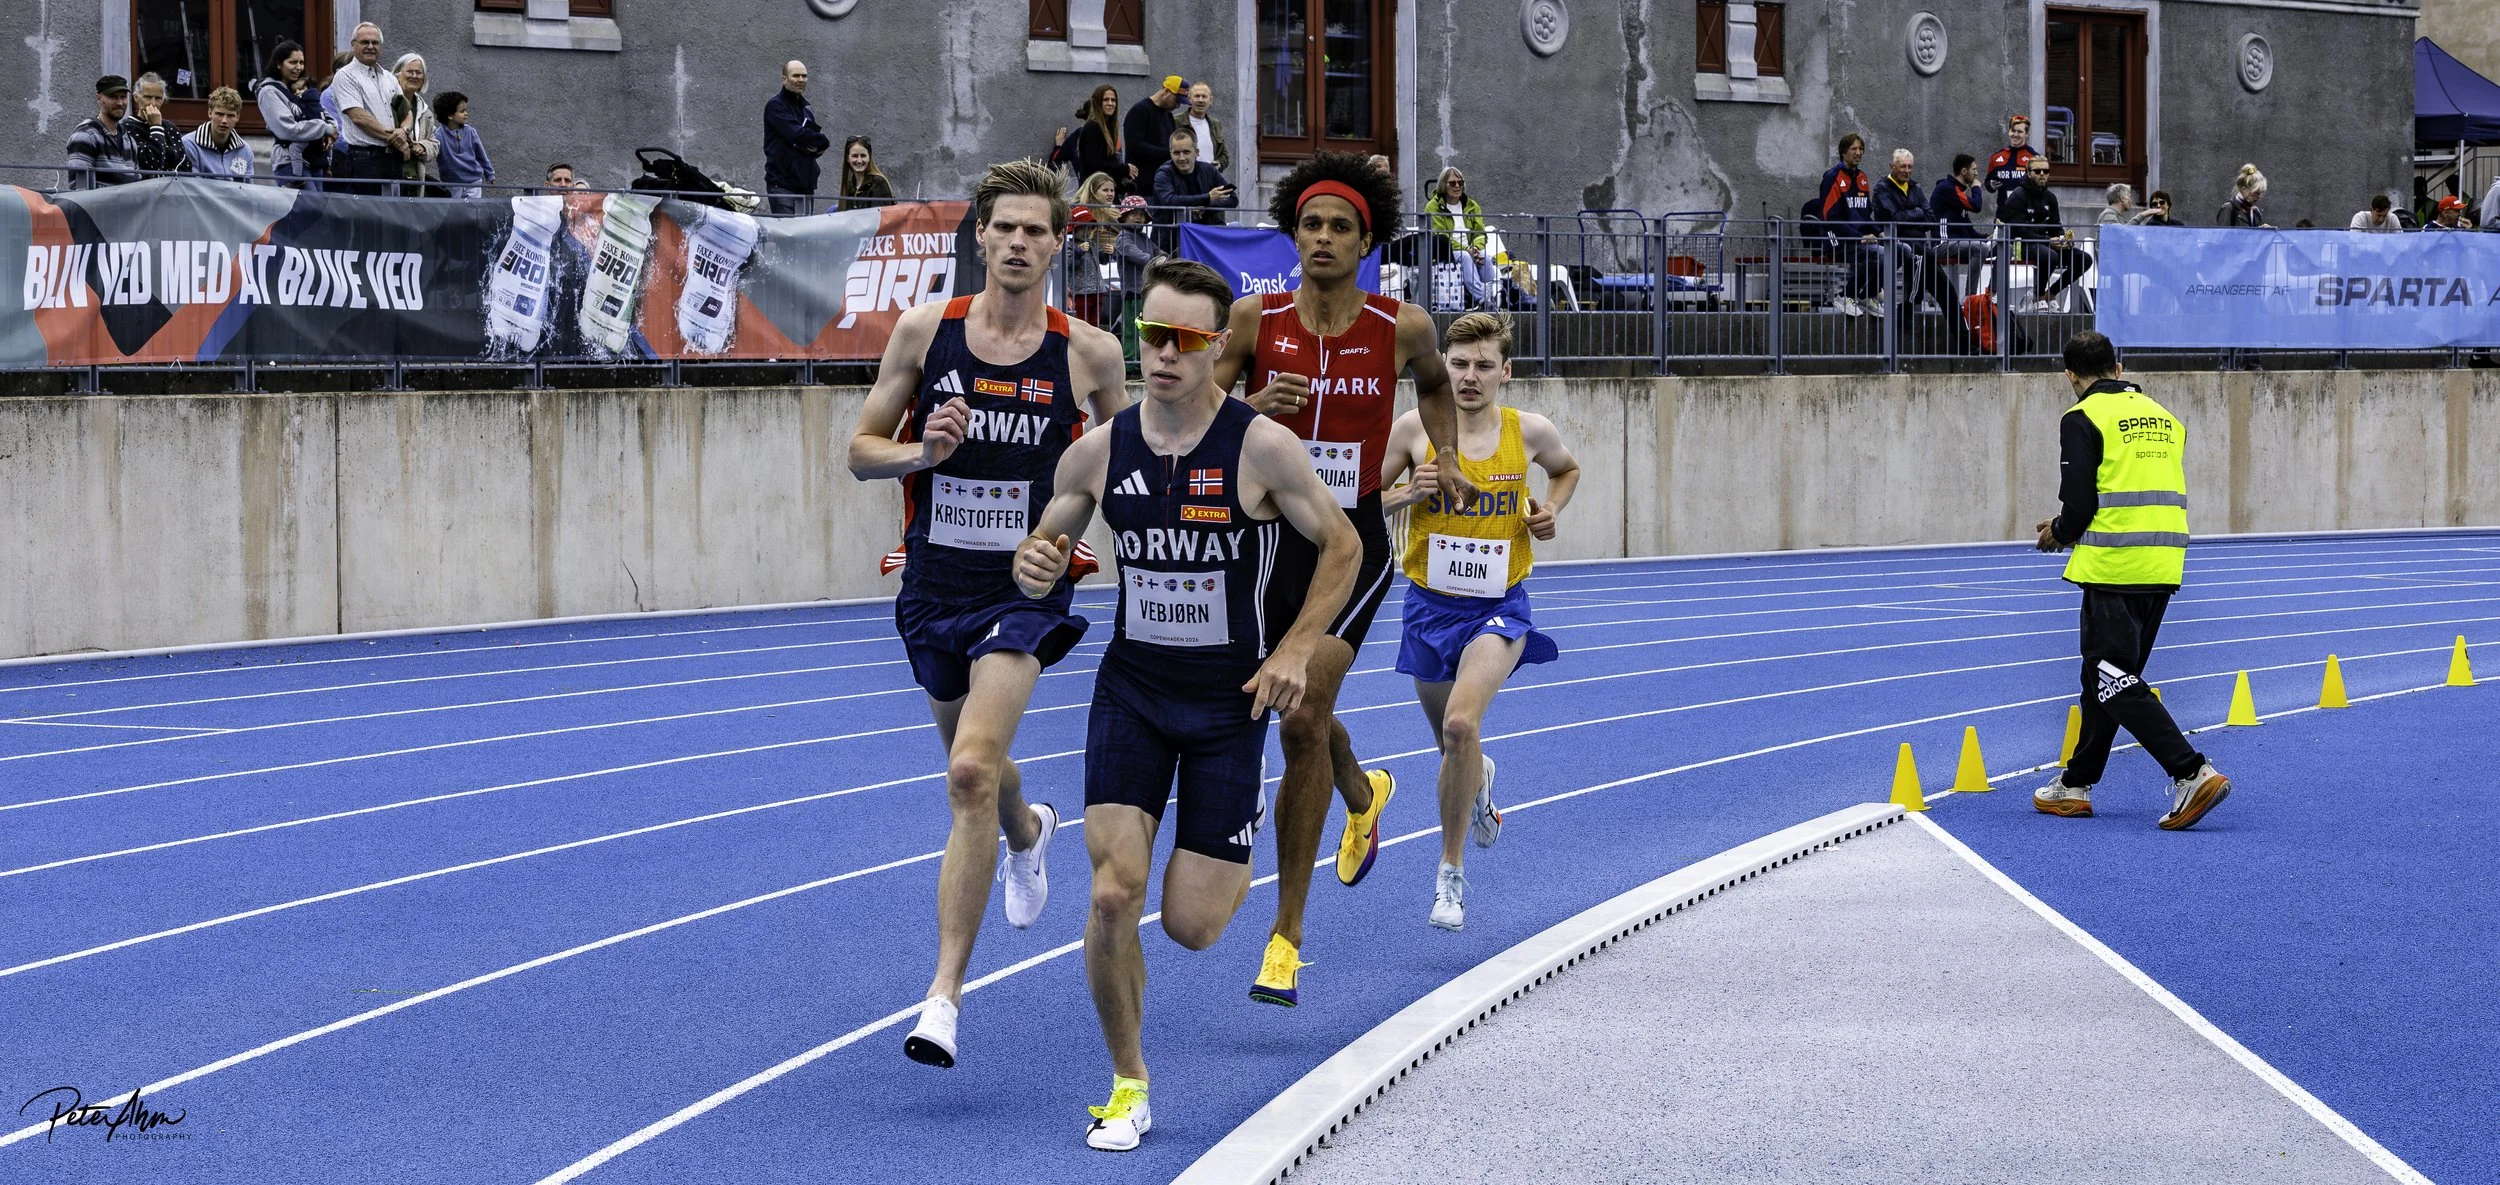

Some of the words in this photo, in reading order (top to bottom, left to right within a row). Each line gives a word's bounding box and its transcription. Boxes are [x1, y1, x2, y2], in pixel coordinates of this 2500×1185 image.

[602, 240, 619, 257] FAXE
[620, 248, 640, 267] KONDI
[696, 244, 713, 260] FAXE
[714, 252, 737, 268] KONDI
[855, 235, 897, 258] FAXE
[901, 232, 958, 256] KONDI
[24, 243, 93, 310] BLIV
[97, 241, 151, 306] VED
[160, 240, 232, 305] MED
[238, 242, 277, 305] AT
[278, 246, 368, 309] BLIVE
[365, 251, 424, 311] VED
[1241, 271, 1288, 293] Dansk
[2186, 284, 2270, 296] ARRANGERET
[2272, 285, 2290, 296] AF
[2315, 276, 2473, 307] SPARTA
[1340, 347, 1363, 356] CRAFT
[988, 384, 1013, 393] EXTRA
[1268, 370, 1381, 396] DMARK
[933, 402, 1051, 446] RWAY
[2118, 416, 2172, 432] SPARTA
[2122, 431, 2175, 444] OFFICIAL
[1197, 510, 1227, 519] EXTRA
[1428, 490, 1519, 517] SWDEN
[935, 503, 1024, 529] KRISTOFFER
[953, 538, 987, 547] COPENHAGEN
[1113, 528, 1246, 562] NORWAY
[1448, 560, 1488, 580] ALBIN
[1139, 599, 1209, 623] VEBJØRN
[1150, 634, 1185, 643] COPENHAGEN
[2097, 674, 2139, 703] adidas
